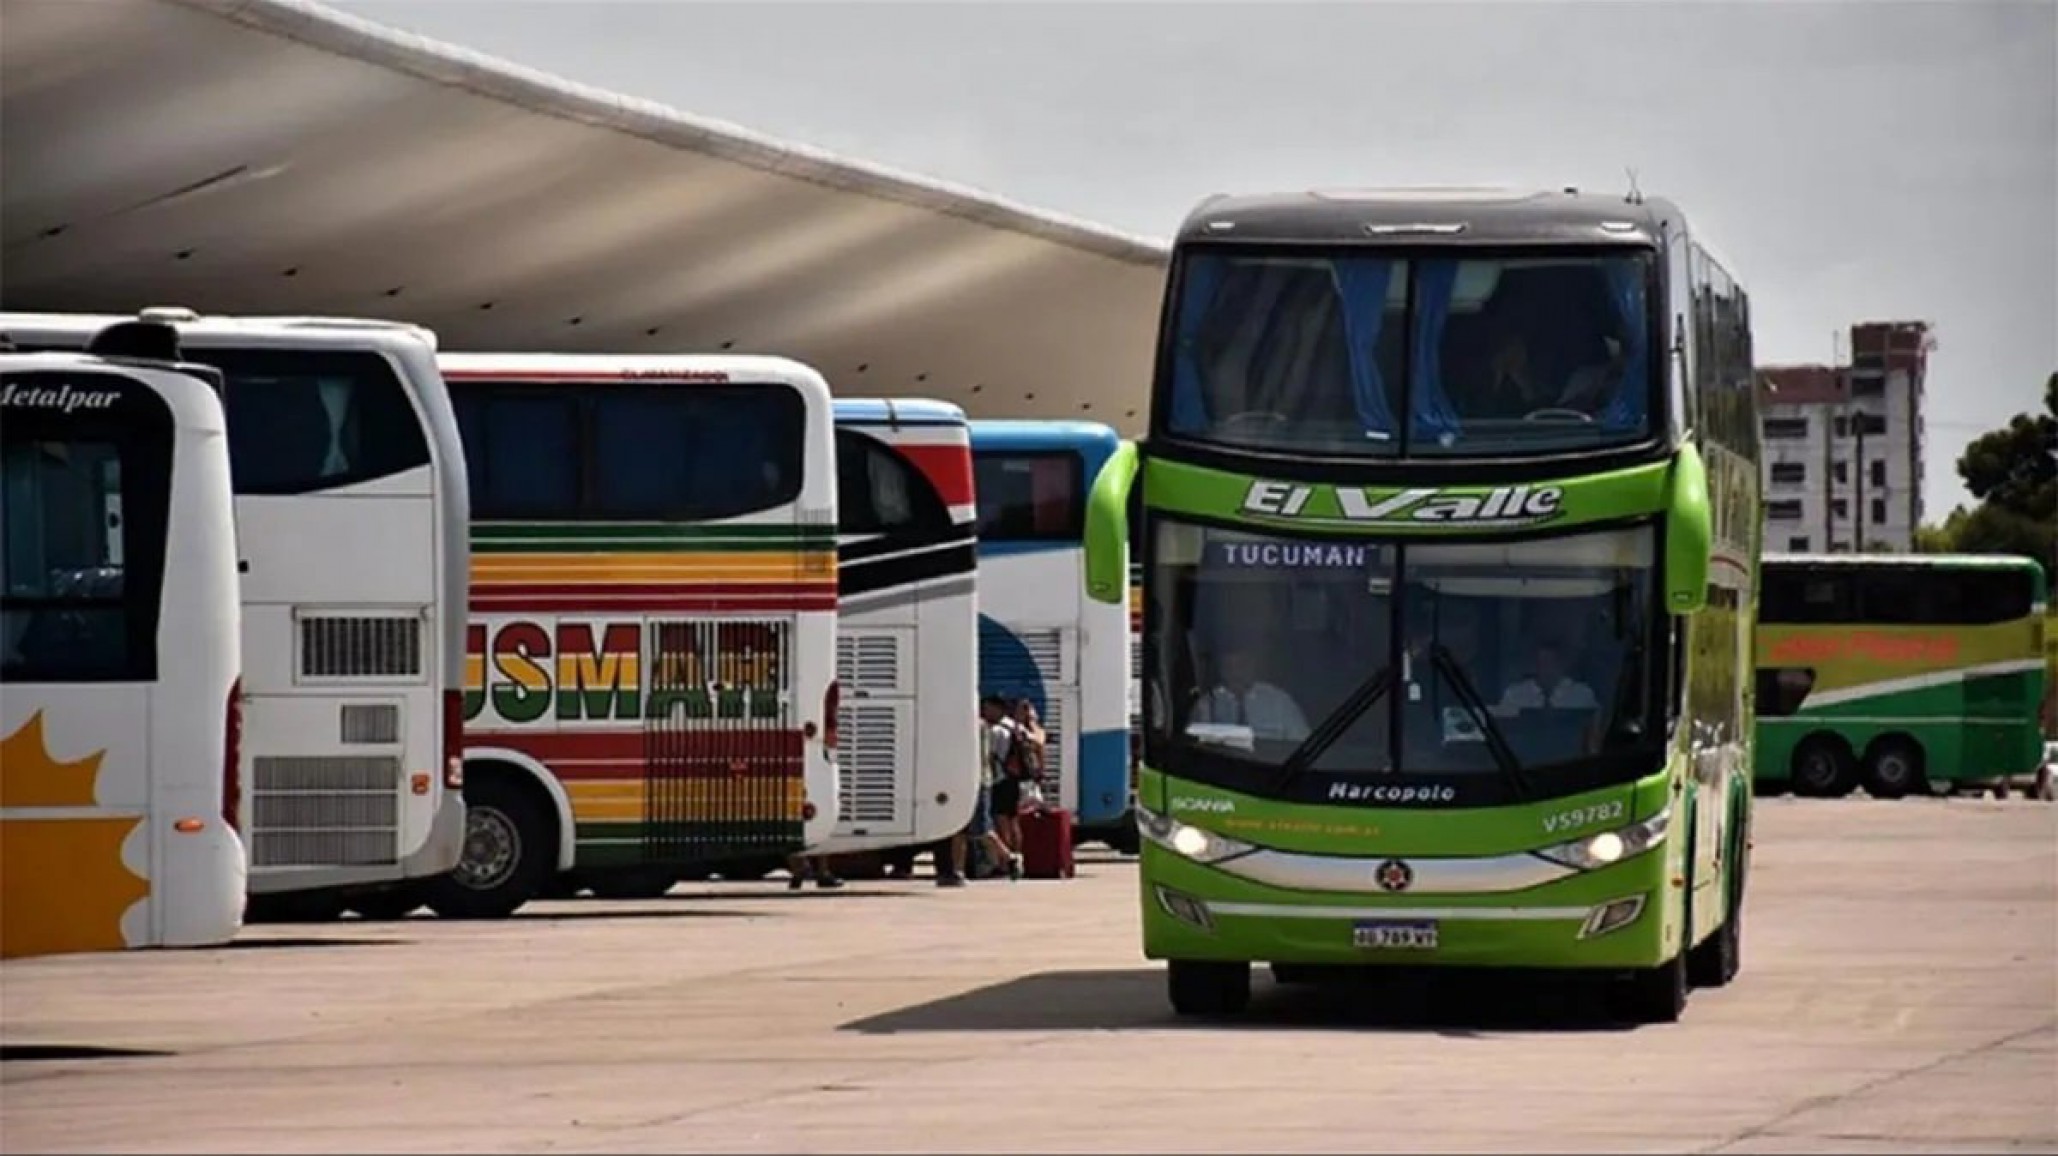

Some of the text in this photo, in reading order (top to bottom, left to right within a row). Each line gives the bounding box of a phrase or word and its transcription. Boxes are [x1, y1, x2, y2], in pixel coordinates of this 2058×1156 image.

[1242, 478, 1562, 520] El Valle
[1224, 545, 1365, 566] TUCUMAN
[1328, 782, 1456, 802] Marcopolo
